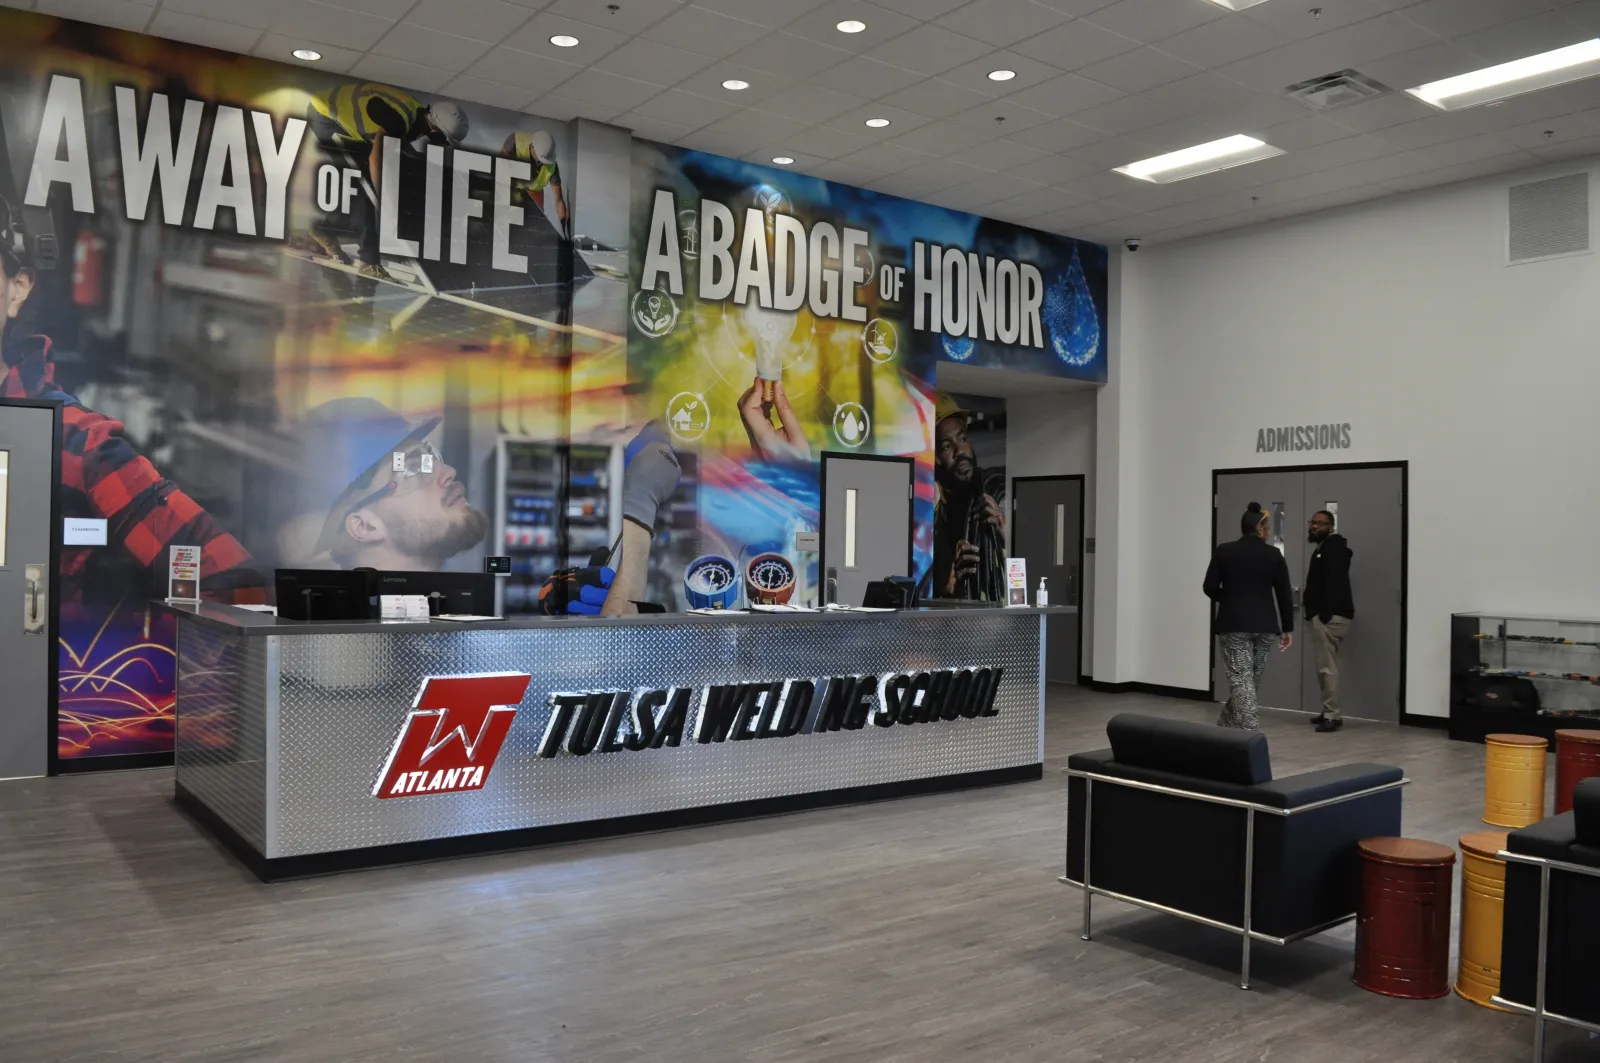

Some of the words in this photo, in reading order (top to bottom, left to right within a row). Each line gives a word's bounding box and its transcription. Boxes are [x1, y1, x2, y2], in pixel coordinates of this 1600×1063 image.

[24, 74, 95, 214] A
[115, 85, 308, 240] WAY
[317, 163, 362, 214] OF
[379, 136, 531, 274] LIFE
[640, 189, 684, 295] A
[699, 198, 869, 322] BADGE
[880, 263, 906, 302] OF
[913, 241, 1044, 348] HONOR
[1256, 422, 1352, 452] ADMISSIONS
[536, 687, 692, 758] TULSA
[693, 674, 877, 744] WELDING
[867, 666, 1004, 728] SCHOOL
[390, 765, 485, 795] ATLANTA
